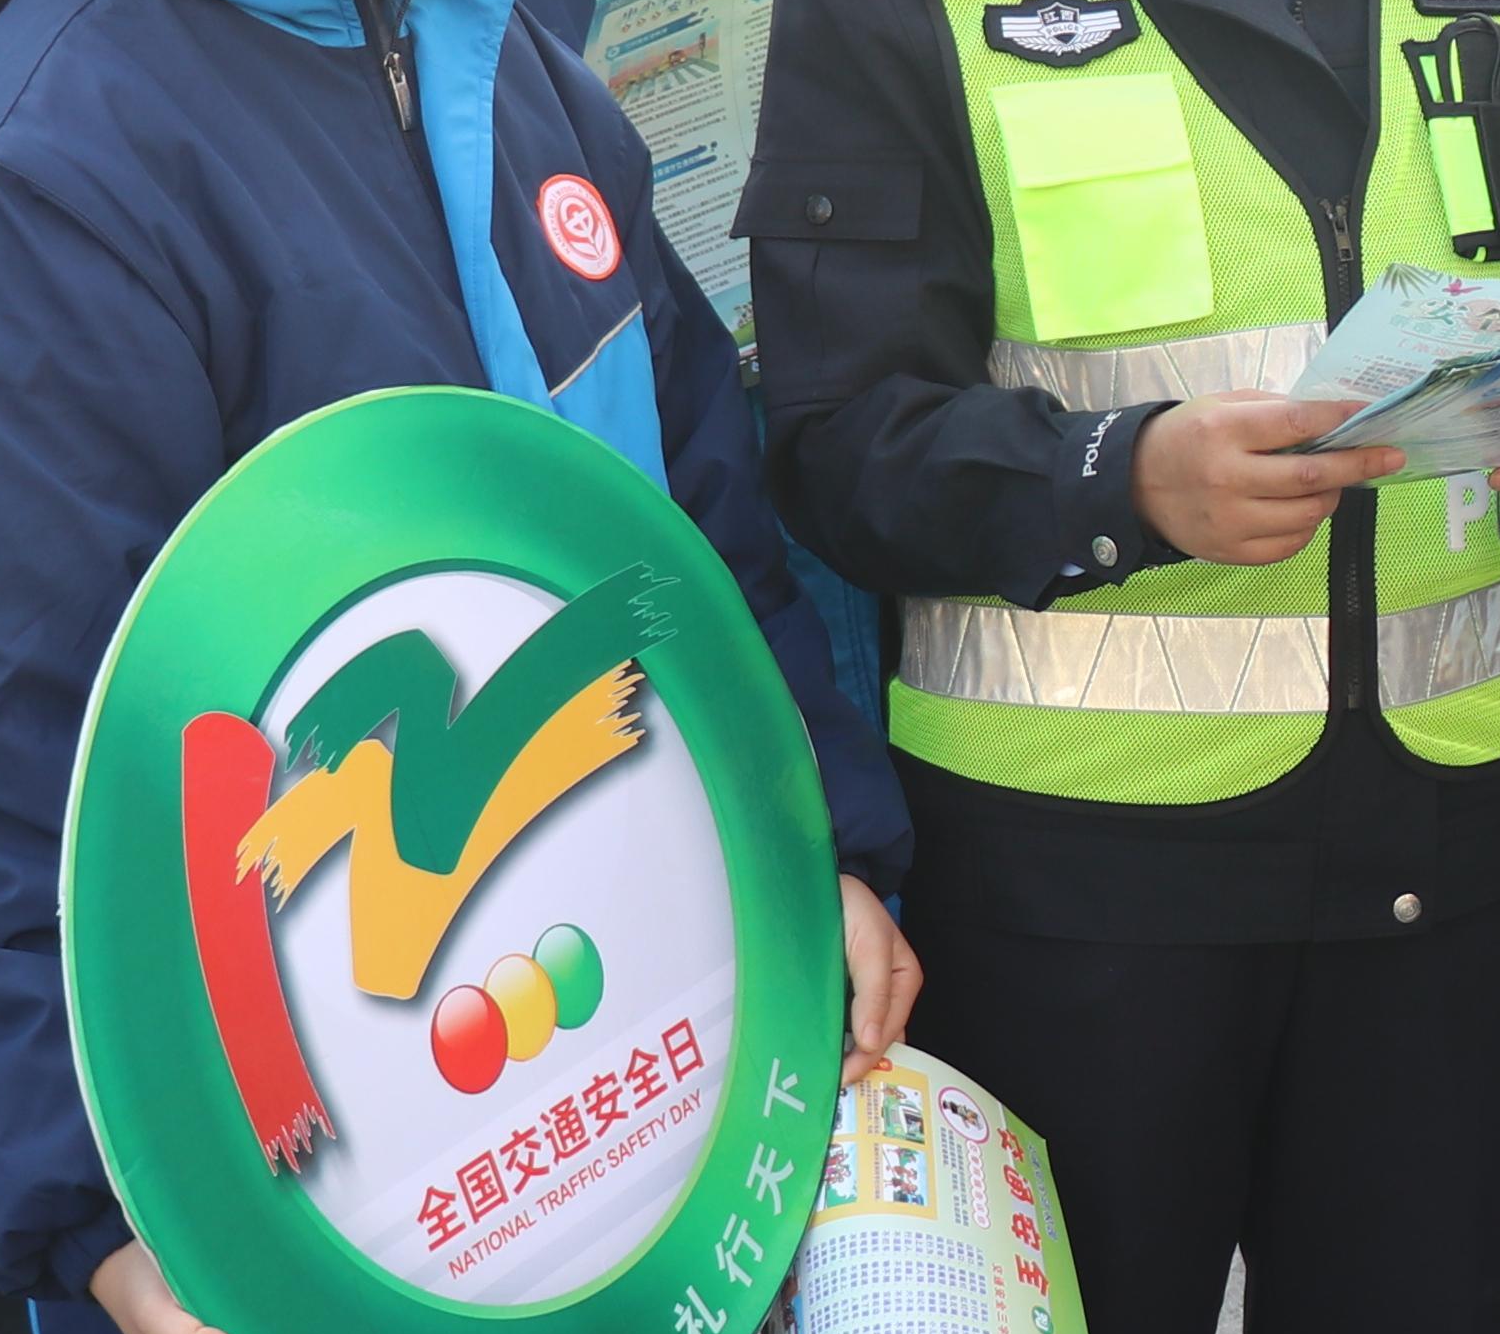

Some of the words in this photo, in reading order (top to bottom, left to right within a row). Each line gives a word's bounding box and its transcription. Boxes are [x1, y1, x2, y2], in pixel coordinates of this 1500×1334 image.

[1046, 23, 1081, 35] POLICE
[416, 1017, 706, 1252] 全国交通安全日
[448, 1210, 536, 1280] NATIONAL
[535, 1157, 607, 1216] TRAFFIC
[606, 1112, 667, 1169] SAFETY
[668, 1088, 703, 1128] DAY
